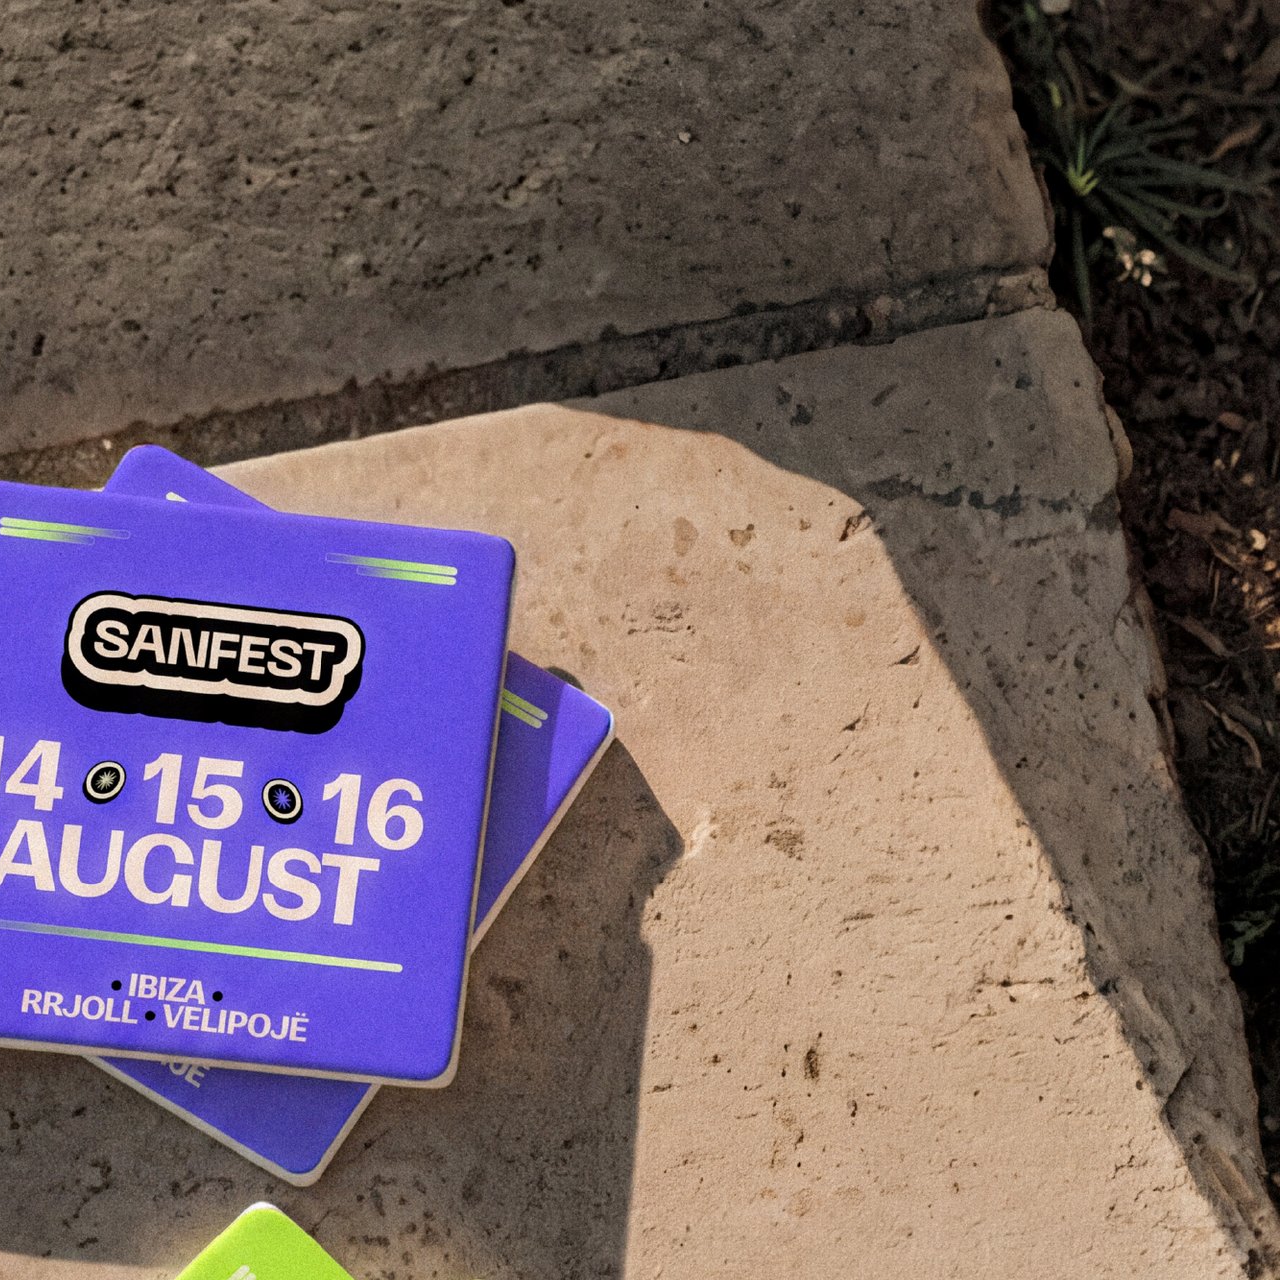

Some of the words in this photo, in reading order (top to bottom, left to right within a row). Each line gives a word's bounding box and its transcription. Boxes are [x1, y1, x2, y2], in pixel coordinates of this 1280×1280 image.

[93, 619, 336, 681] SANFEST
[143, 752, 245, 830] 15
[322, 772, 425, 851] 16
[20, 988, 138, 1025] RRJOLL
[162, 1003, 310, 1043] VELIPOJË
[127, 972, 206, 1005] IBIZA
